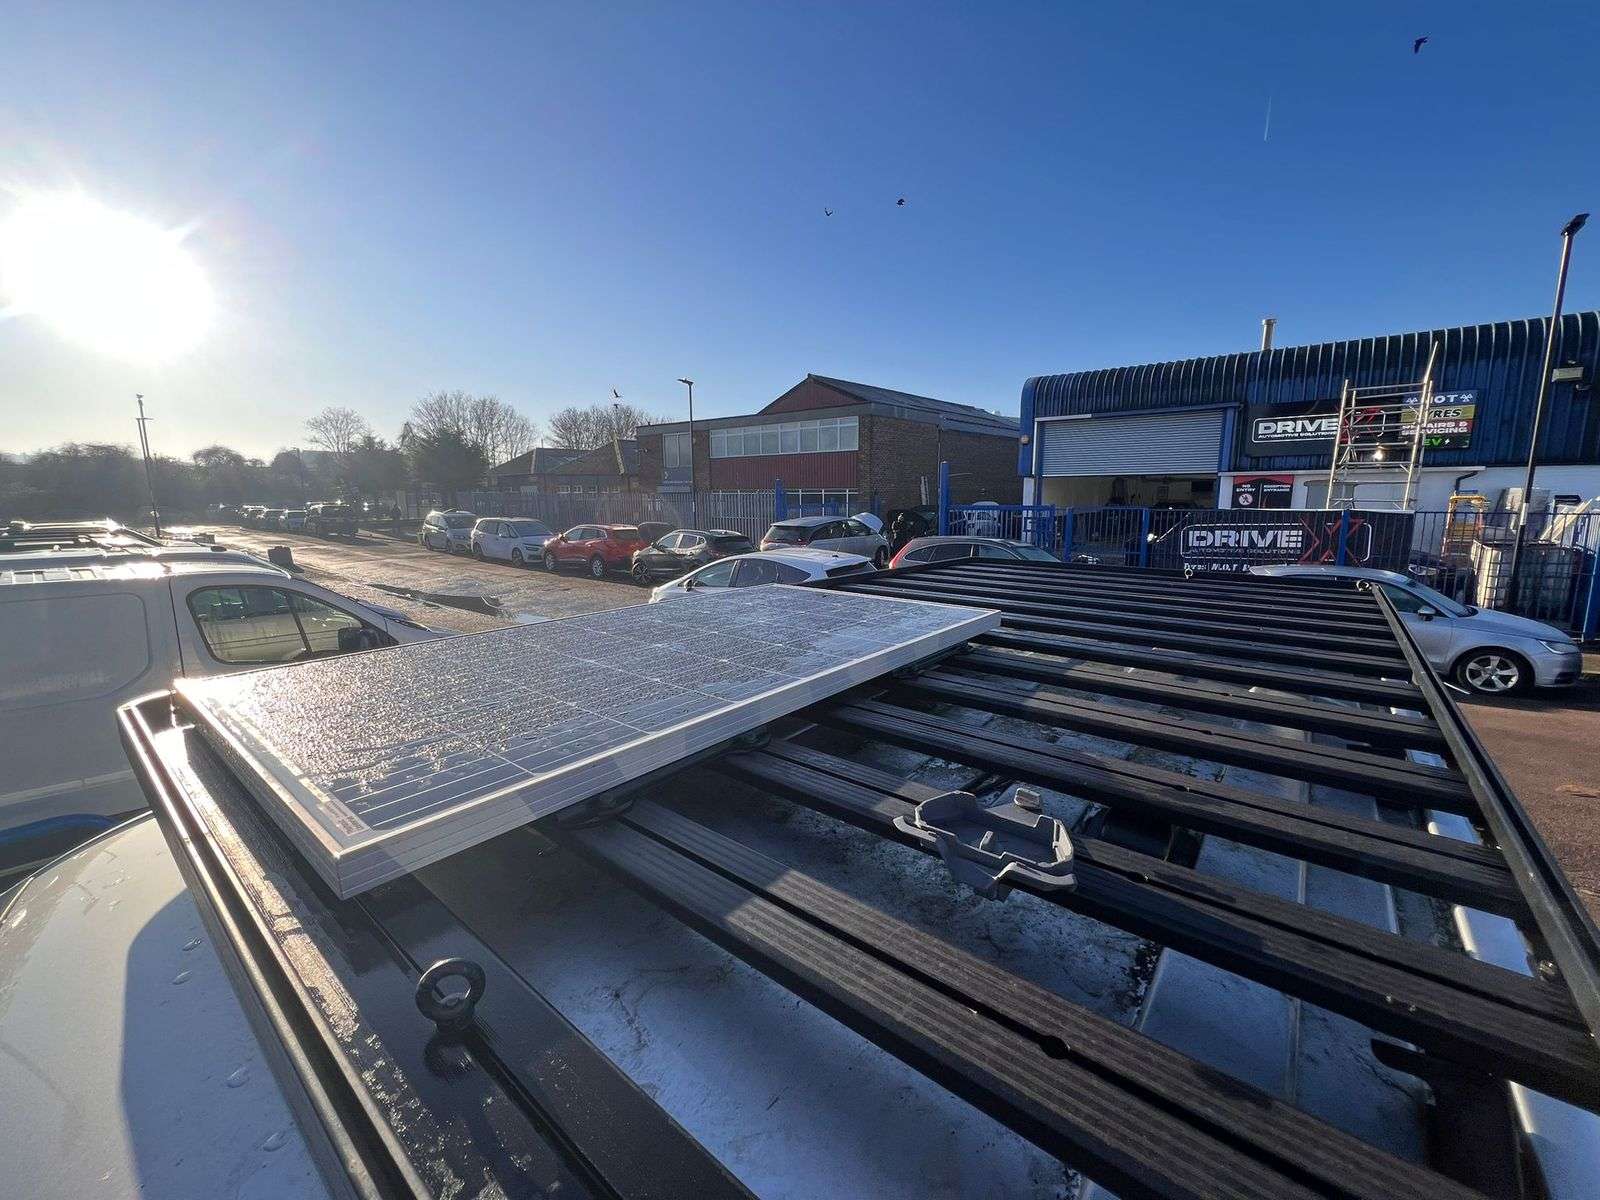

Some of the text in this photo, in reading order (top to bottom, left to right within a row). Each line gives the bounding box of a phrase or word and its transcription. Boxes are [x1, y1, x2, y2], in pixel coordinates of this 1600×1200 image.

[1258, 418, 1339, 434] DRIVE
[1401, 427, 1468, 436] SEVICING
[1188, 530, 1302, 548] DRIVE
